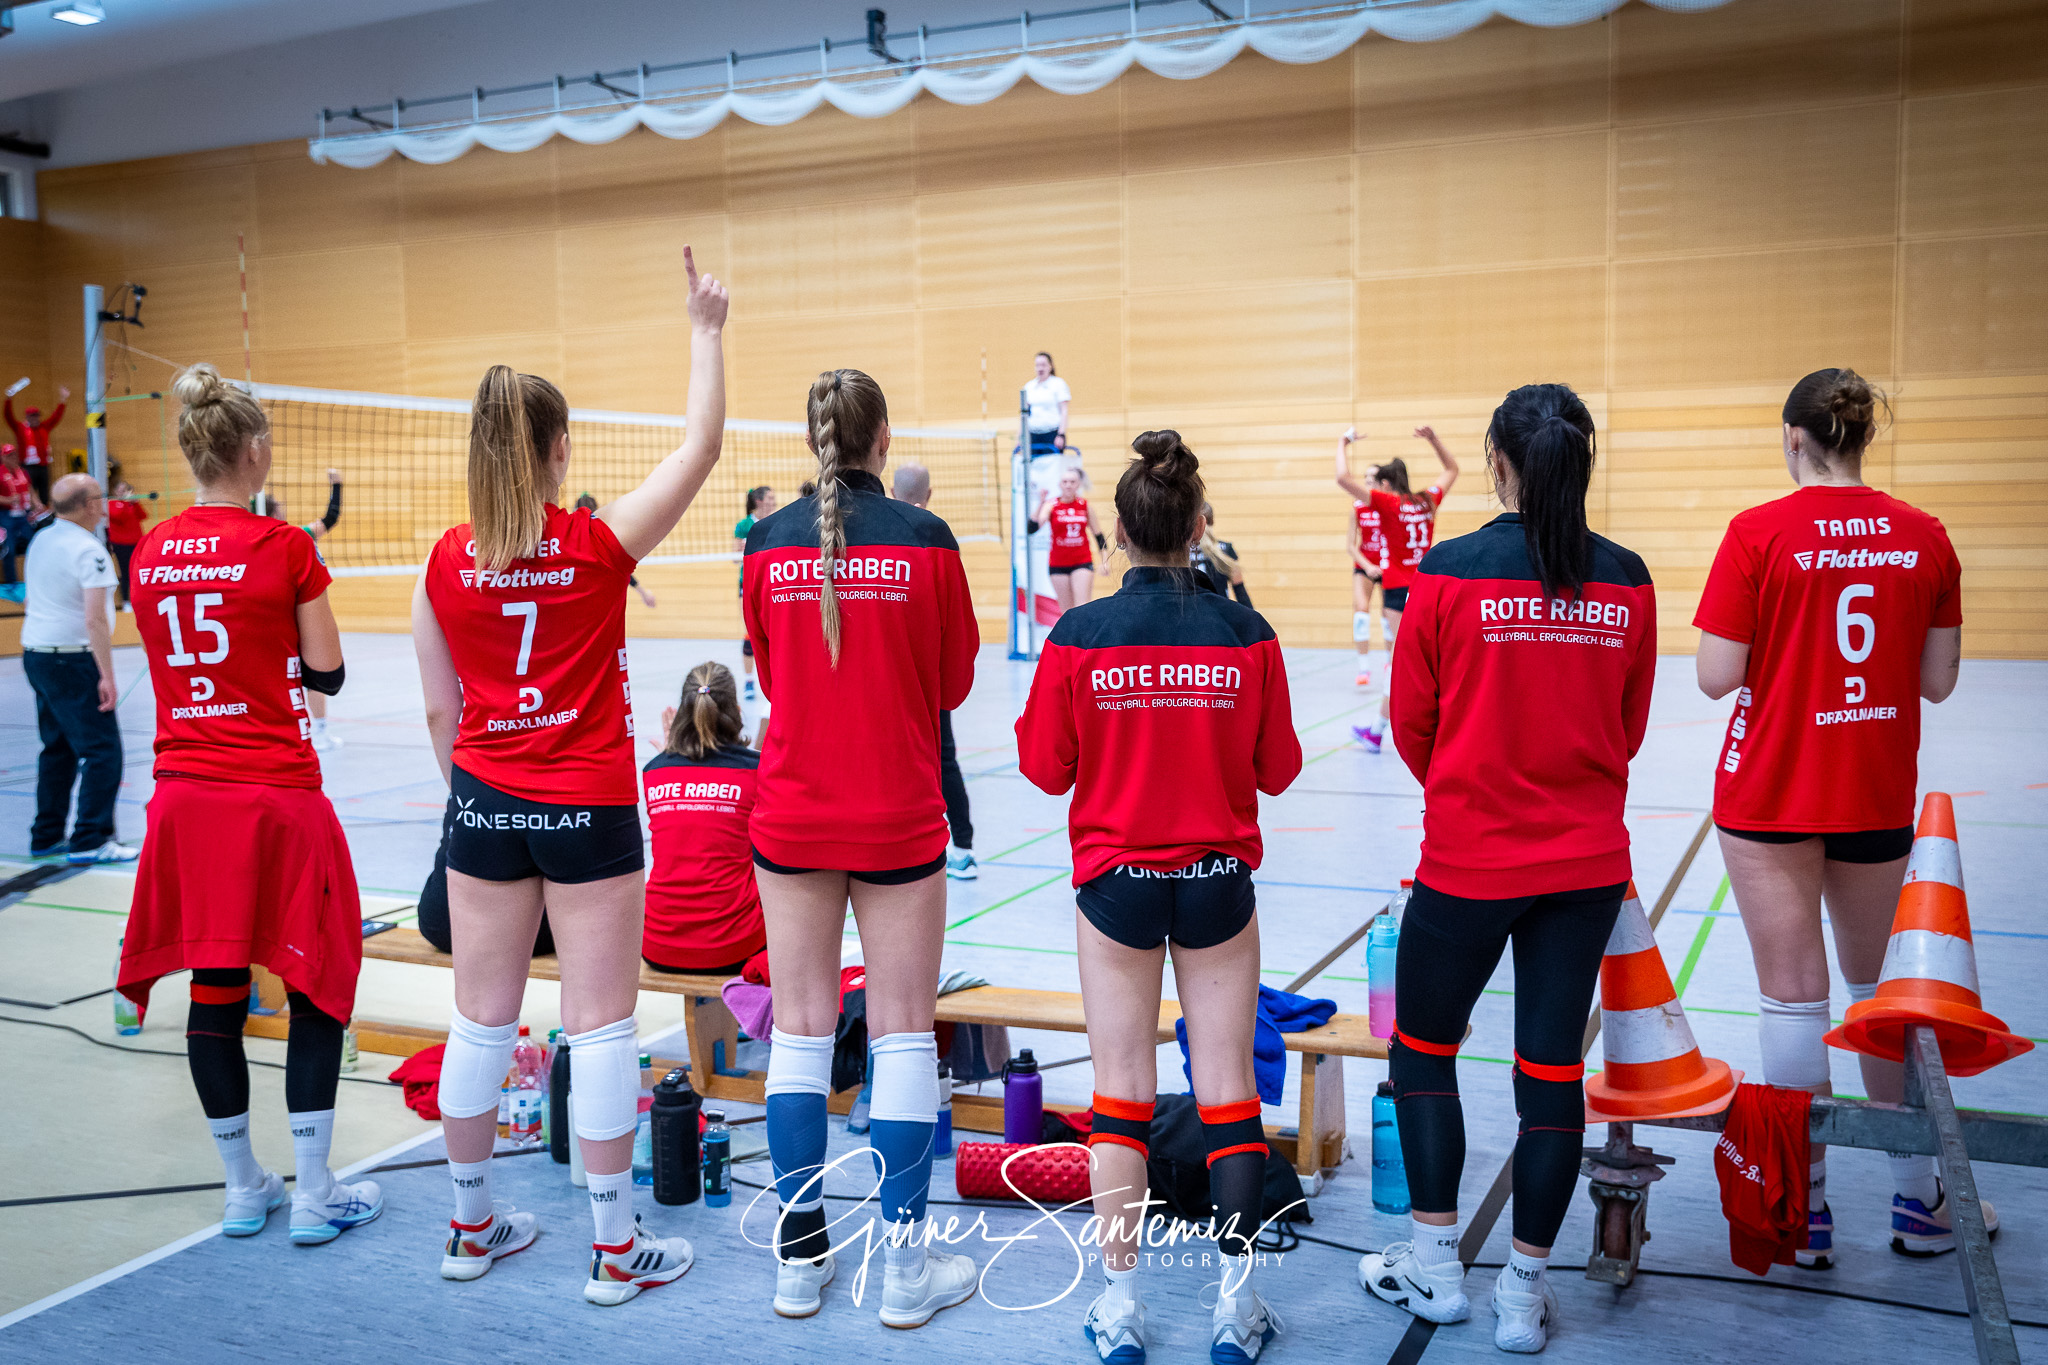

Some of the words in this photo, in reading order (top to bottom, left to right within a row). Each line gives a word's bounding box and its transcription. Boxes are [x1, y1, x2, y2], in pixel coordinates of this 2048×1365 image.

[1405, 522, 1429, 549] 11
[1814, 517, 1892, 537] TAMIS
[161, 536, 221, 556] PIEST
[769, 558, 827, 584] ROTE
[833, 557, 911, 582] RABEN
[1815, 548, 1919, 569] Flottweg
[150, 563, 247, 584] Flottweg
[476, 566, 575, 588] Flottweg
[1480, 597, 1543, 622] ROTE
[1550, 598, 1630, 628] RABEN
[1835, 583, 1876, 663] 6
[157, 592, 230, 667] 15
[502, 601, 538, 676] 7
[1091, 664, 1153, 691] ROTE
[1160, 663, 1241, 689] RABEN
[487, 708, 579, 732] DRÄXLMAIER
[647, 782, 682, 802] ROTE
[684, 782, 742, 801] RABEN
[463, 810, 592, 831] ONESOLAR
